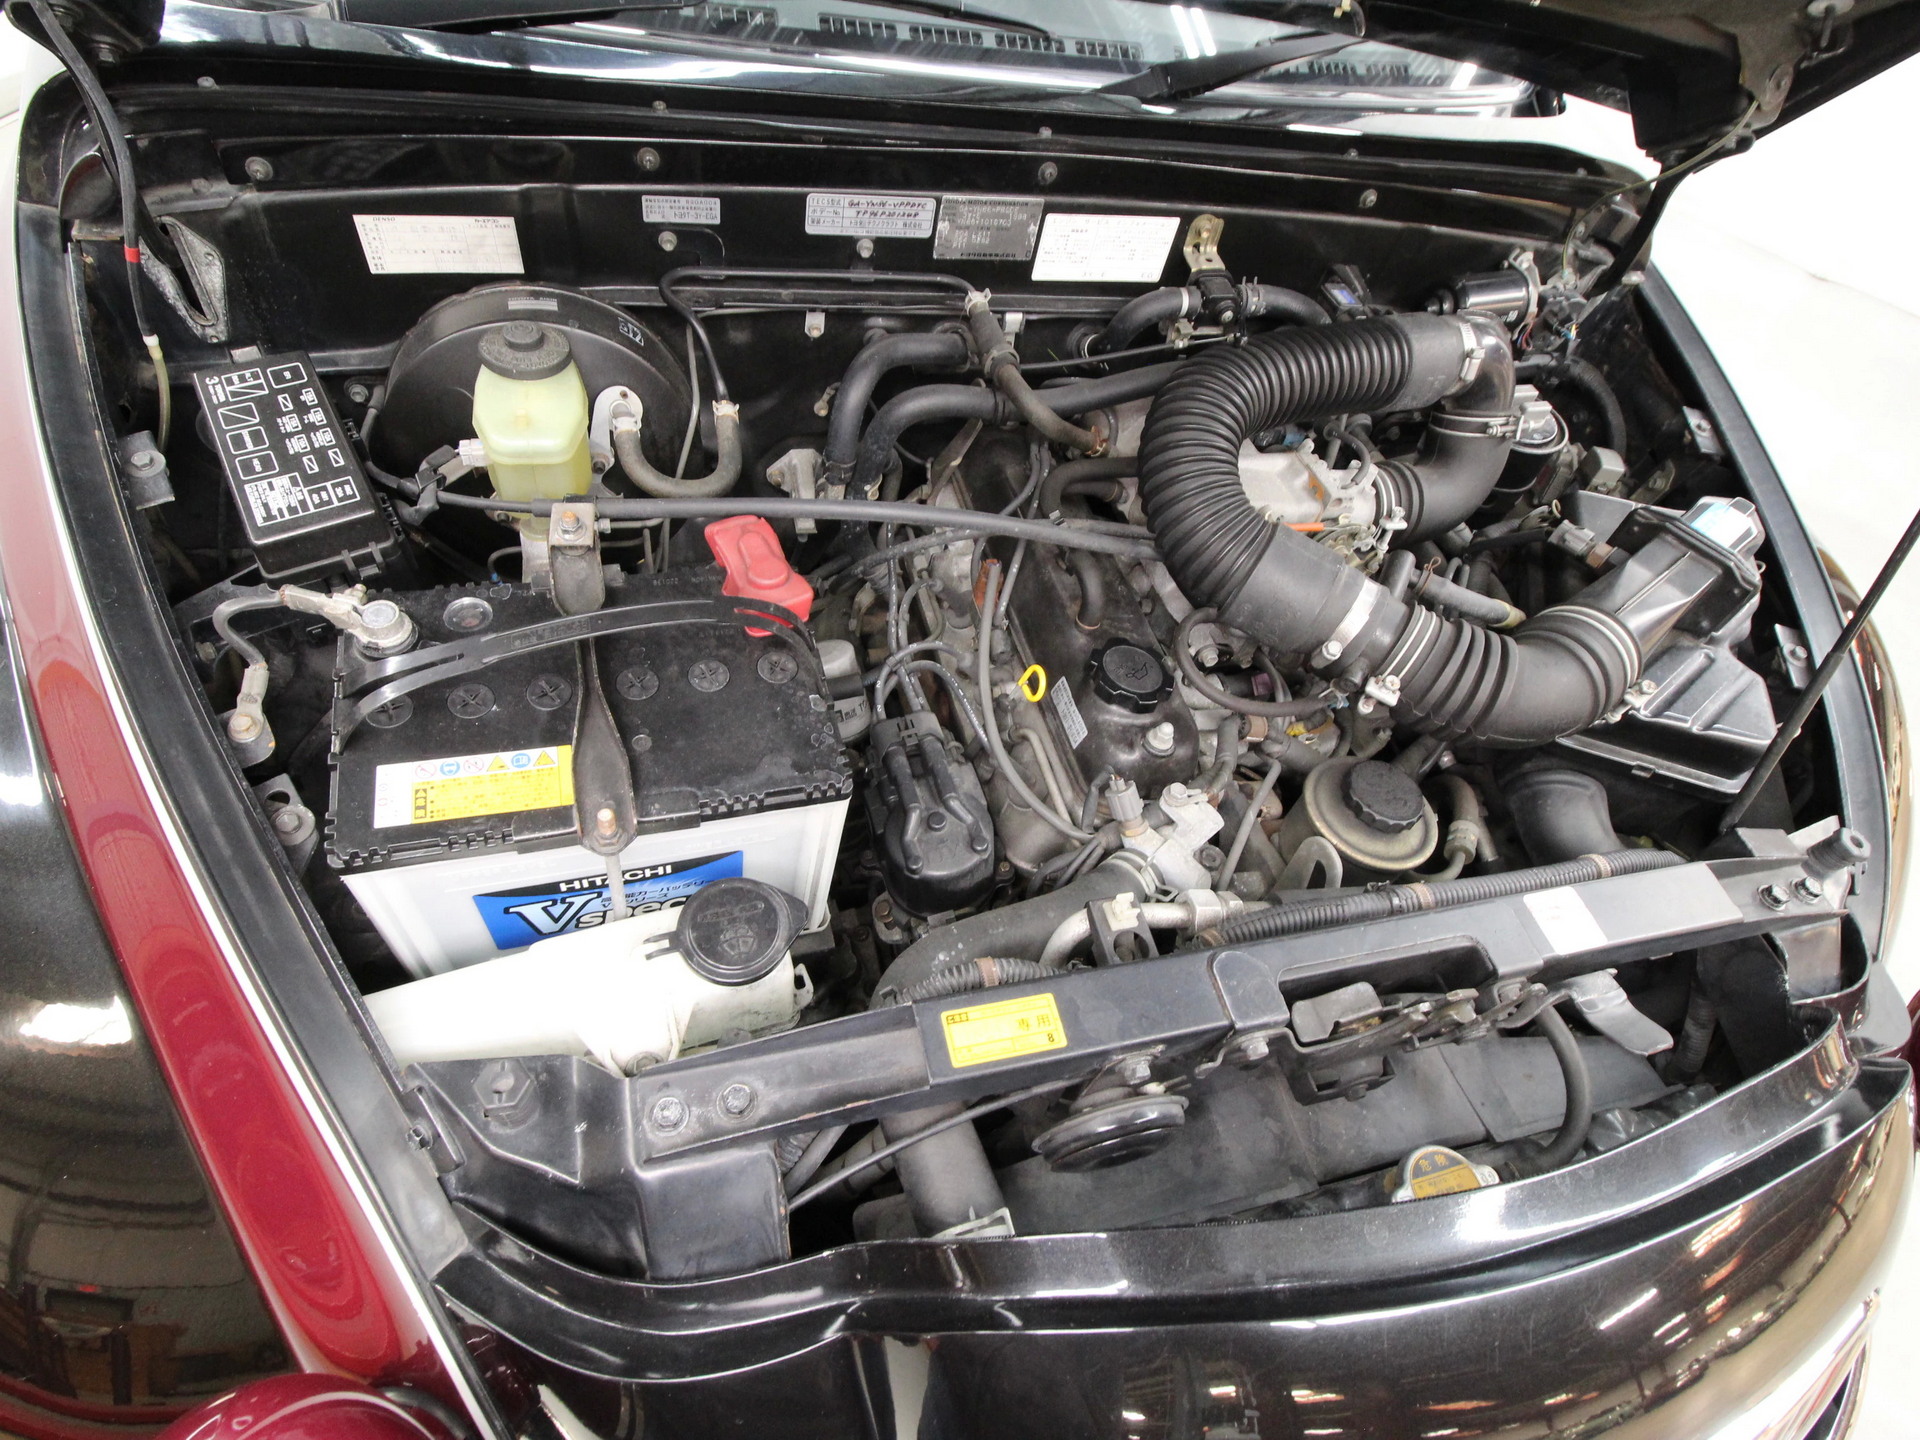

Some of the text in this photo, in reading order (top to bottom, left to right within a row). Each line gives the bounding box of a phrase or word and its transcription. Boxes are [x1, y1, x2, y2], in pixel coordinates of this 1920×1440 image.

[206, 375, 218, 384] 3
[559, 864, 673, 892] HITCHI
[1047, 1032, 1055, 1043] 8
[1418, 1154, 1449, 1173] 危険
